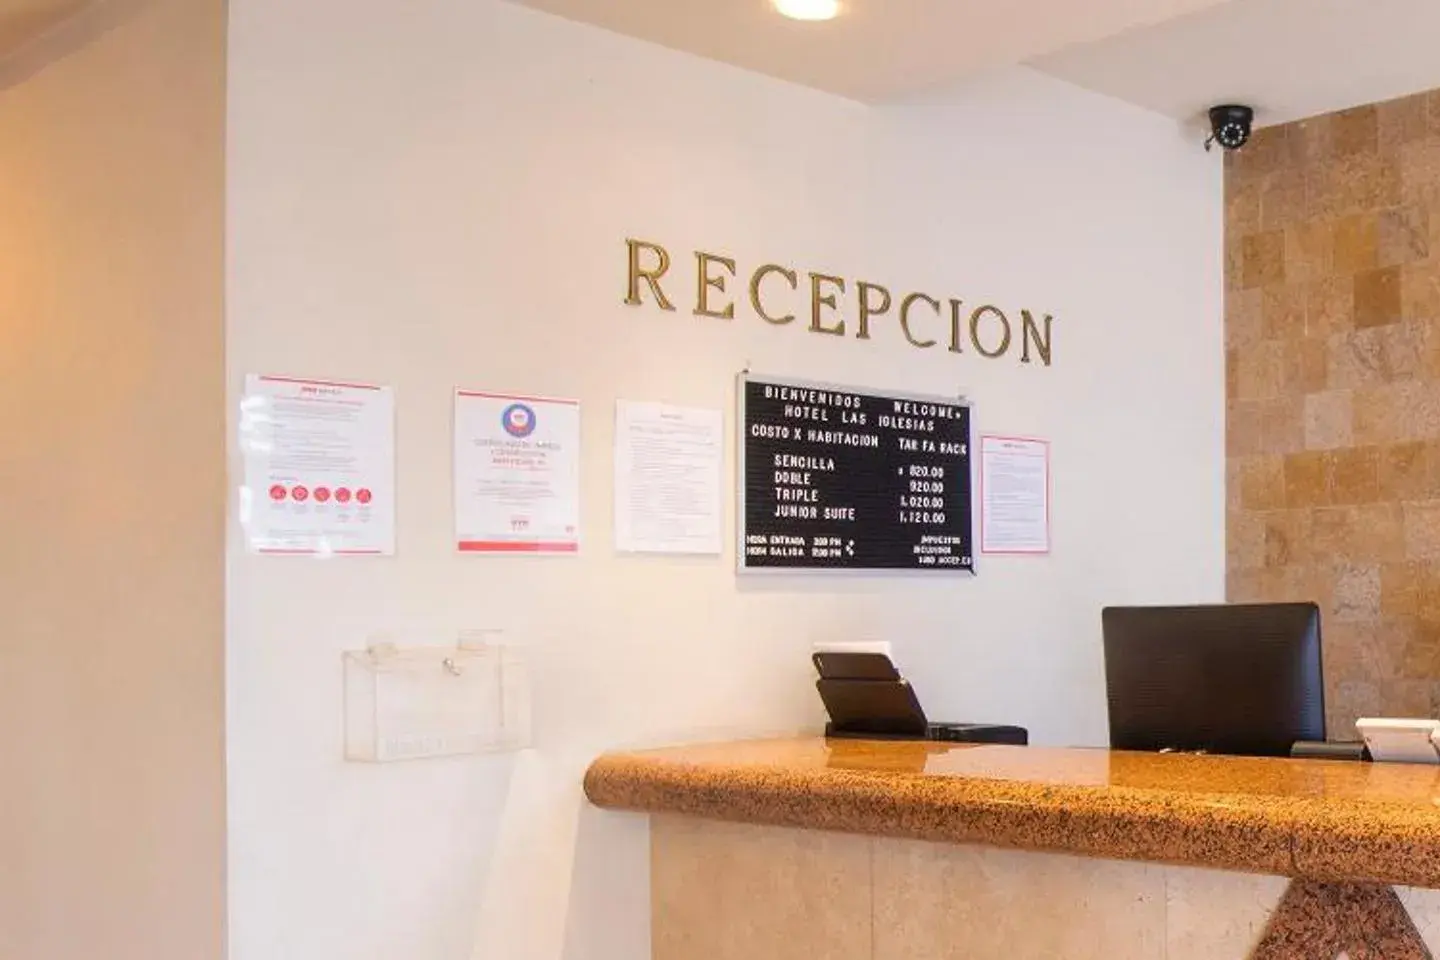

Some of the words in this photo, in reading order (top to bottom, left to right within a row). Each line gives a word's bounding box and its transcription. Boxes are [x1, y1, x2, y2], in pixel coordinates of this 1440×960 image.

[623, 237, 1054, 368] RECEPCION
[765, 385, 861, 408] BIENVENIDOS
[894, 401, 954, 420] WELCOME
[785, 405, 829, 422] HOTEL
[842, 411, 867, 426] LAS
[878, 416, 935, 432] IGLESIAS
[751, 424, 789, 438] COSTO
[794, 429, 801, 440] X
[807, 430, 879, 448] HABITACION
[940, 443, 967, 455] RACK
[774, 454, 835, 472] SENCILLA
[774, 470, 811, 485] DOBLE
[909, 481, 944, 494] 920.00
[775, 488, 819, 502] TRIPLE
[774, 504, 817, 519] JUNIOR
[824, 507, 855, 522] SUITE
